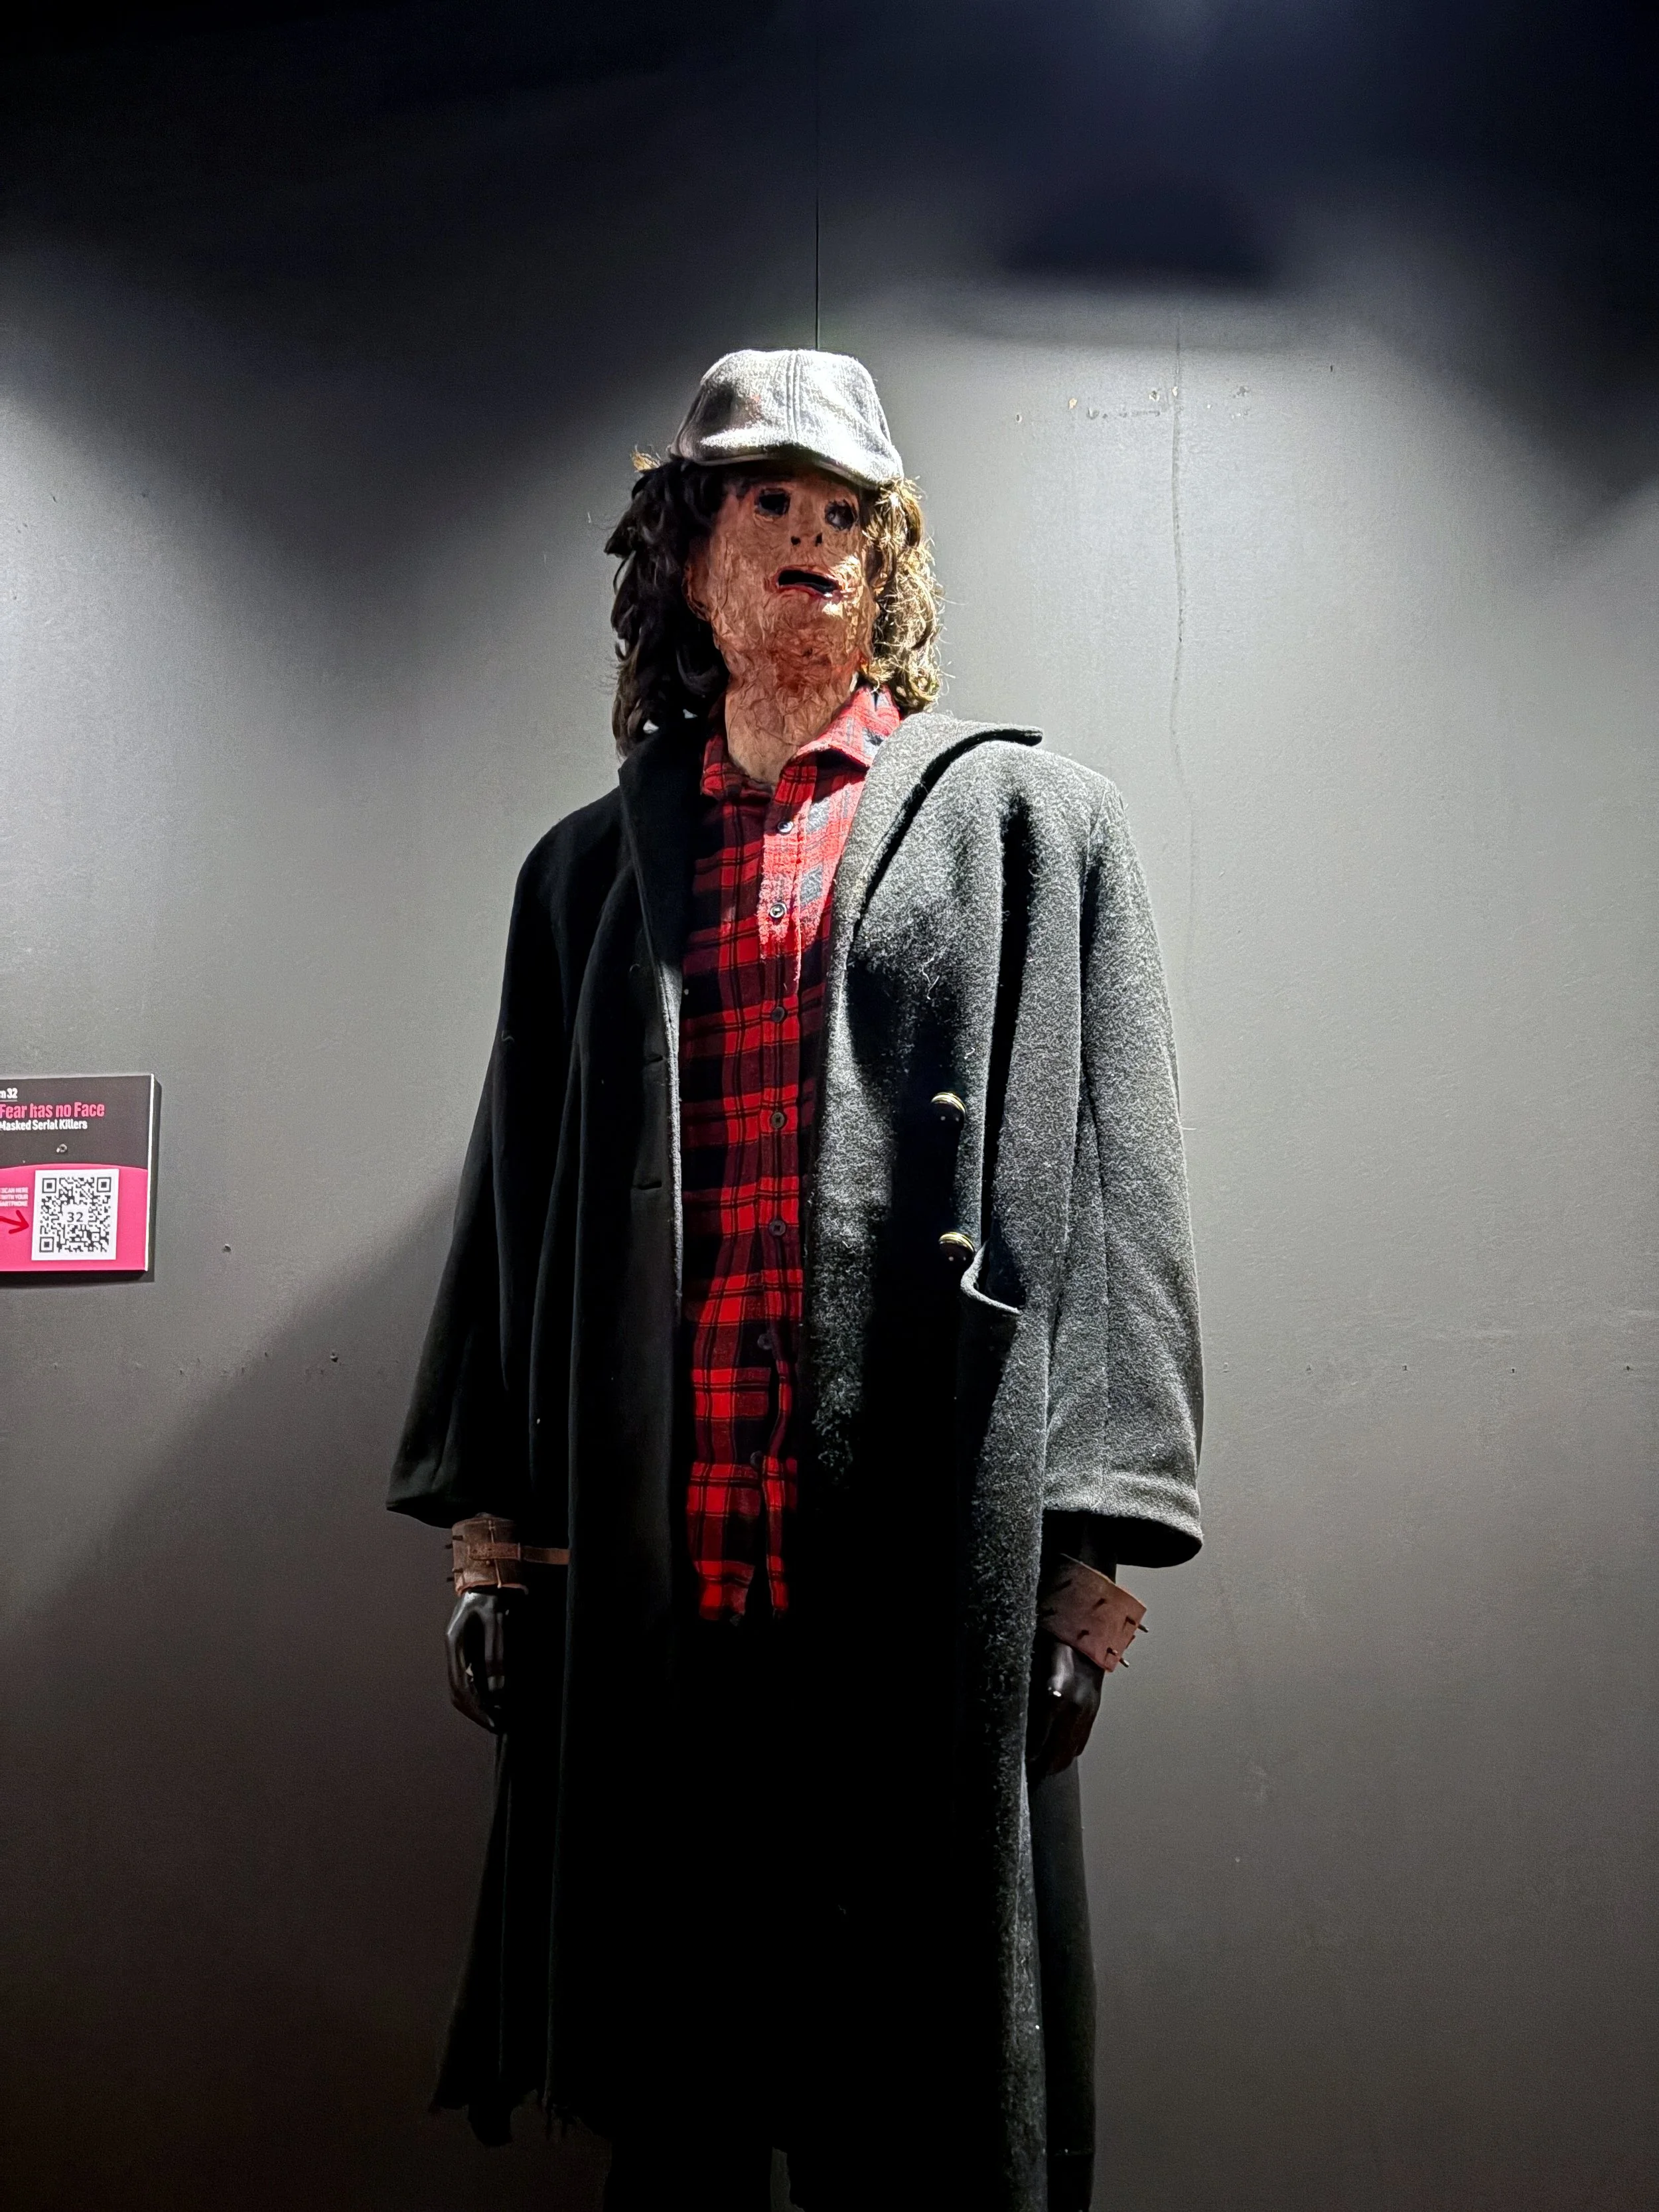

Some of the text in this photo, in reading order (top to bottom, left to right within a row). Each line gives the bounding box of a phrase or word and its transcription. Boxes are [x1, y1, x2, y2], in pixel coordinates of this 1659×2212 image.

[7, 1088, 18, 1099] 32
[0, 1102, 105, 1118] Fear has no Face
[0, 1118, 88, 1131] Masked Serial Killers
[67, 1212, 83, 1222] 32
